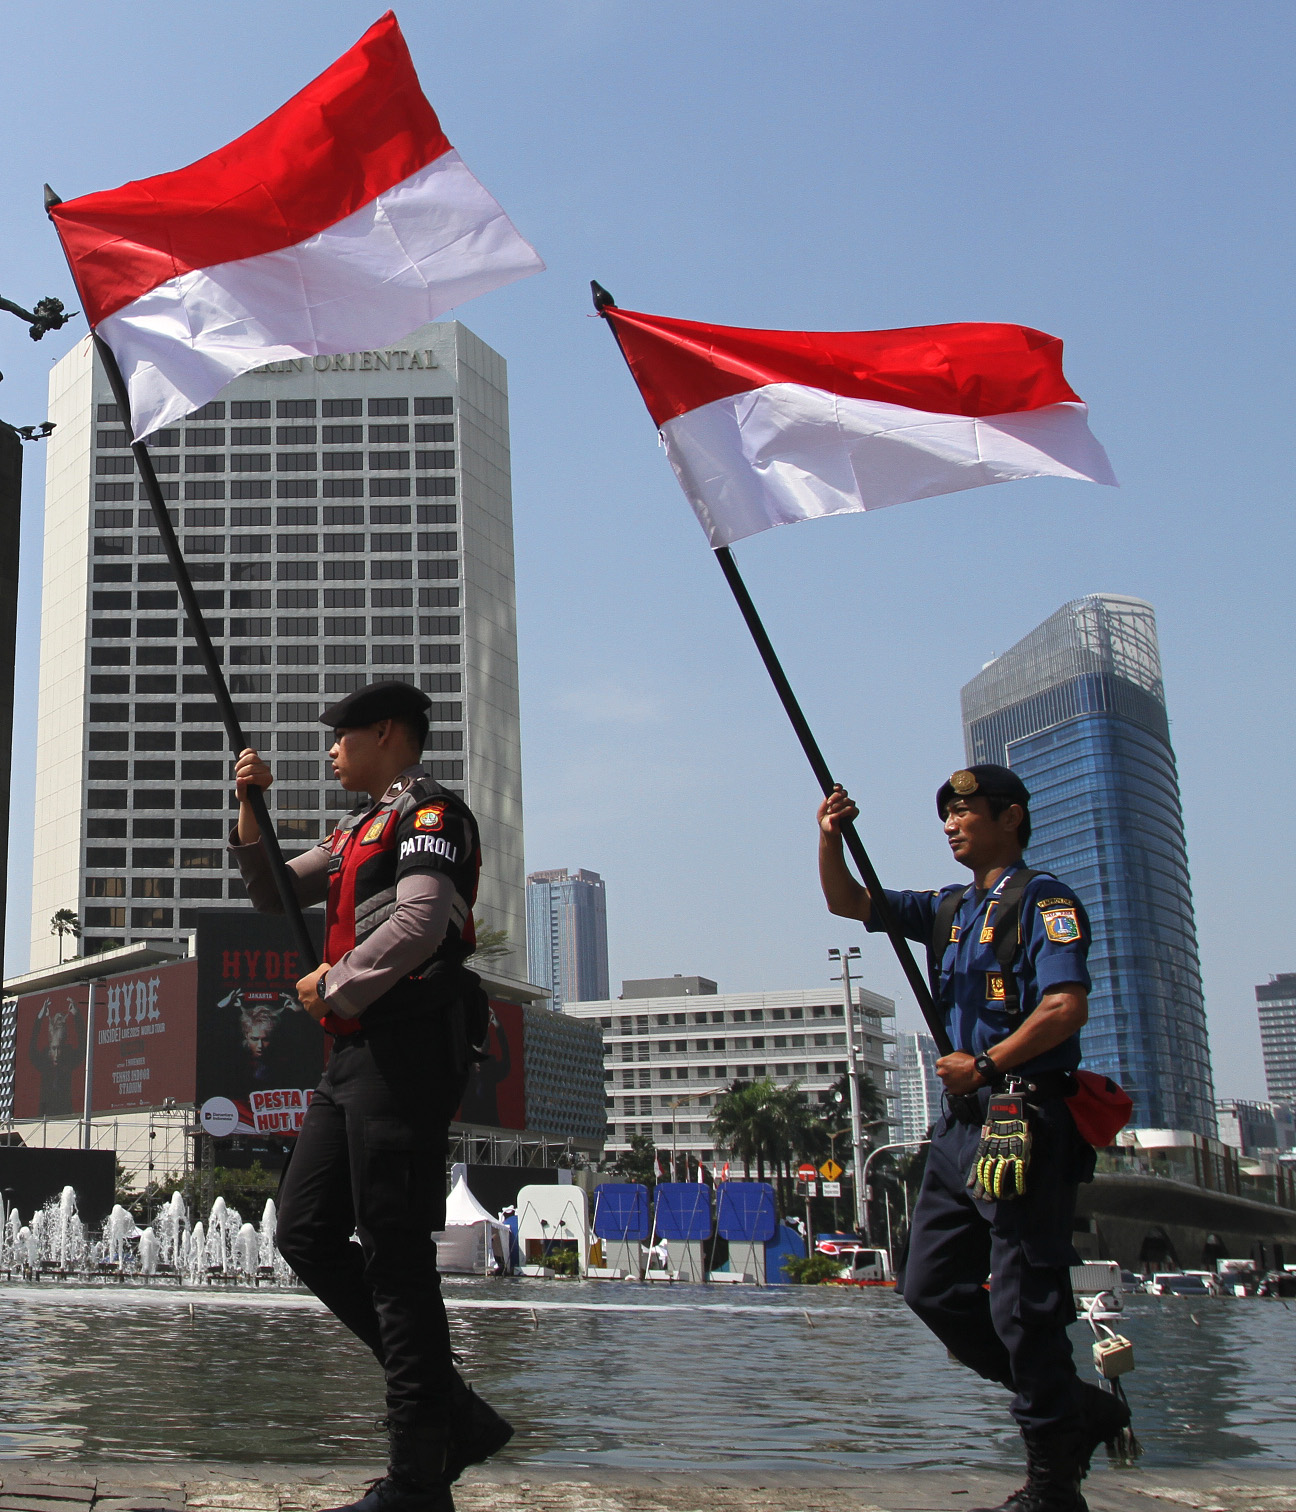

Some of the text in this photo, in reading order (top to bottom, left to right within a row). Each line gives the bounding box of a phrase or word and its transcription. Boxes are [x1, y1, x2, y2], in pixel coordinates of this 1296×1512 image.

[312, 350, 438, 372] ORIENTAL
[399, 834, 457, 863] PATROLI
[221, 949, 301, 980] HYDE
[107, 975, 160, 1028] HYDE
[118, 1082, 142, 1095] STADIUM
[253, 1090, 302, 1110] PESTA
[256, 1111, 290, 1131] HUT
